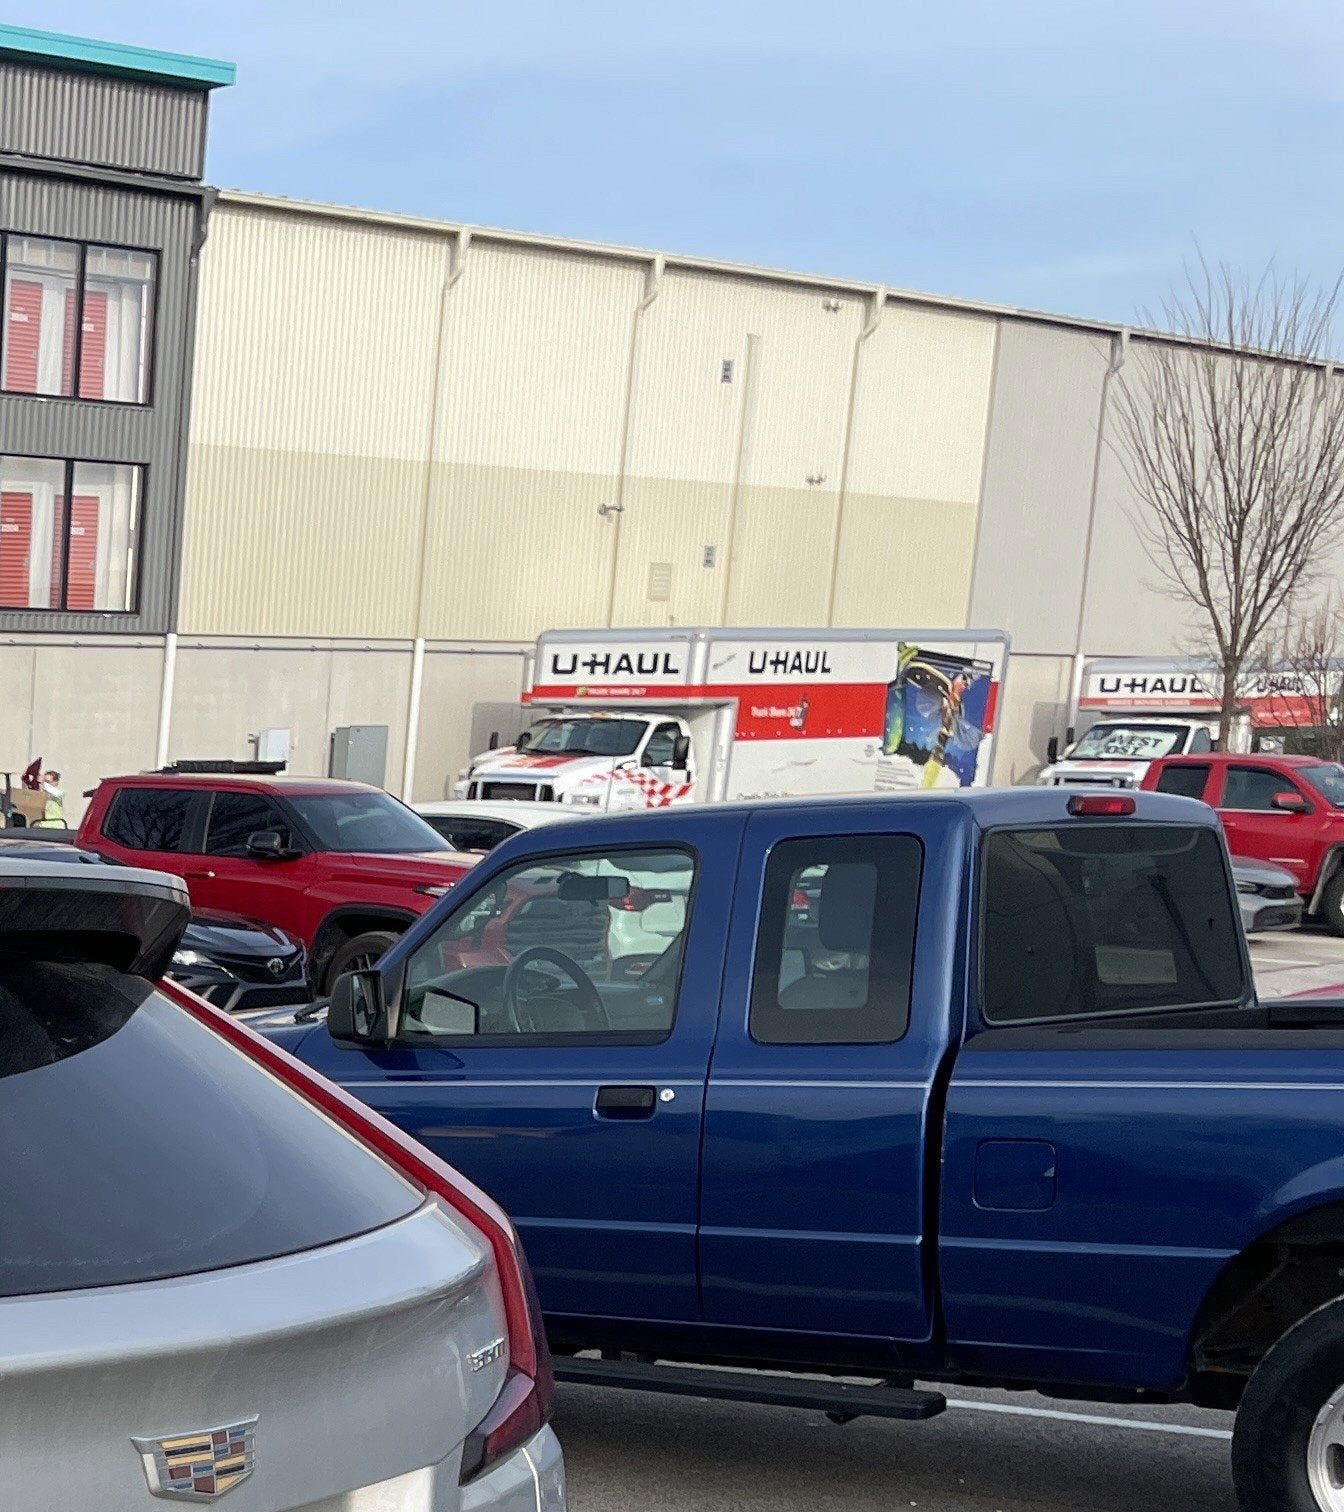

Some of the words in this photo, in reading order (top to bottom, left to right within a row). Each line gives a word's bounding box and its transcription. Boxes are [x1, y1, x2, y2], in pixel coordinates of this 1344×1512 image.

[552, 653, 679, 675] U-HAUL
[749, 651, 831, 674] U-HAUL
[1100, 677, 1203, 693] U-HAUL
